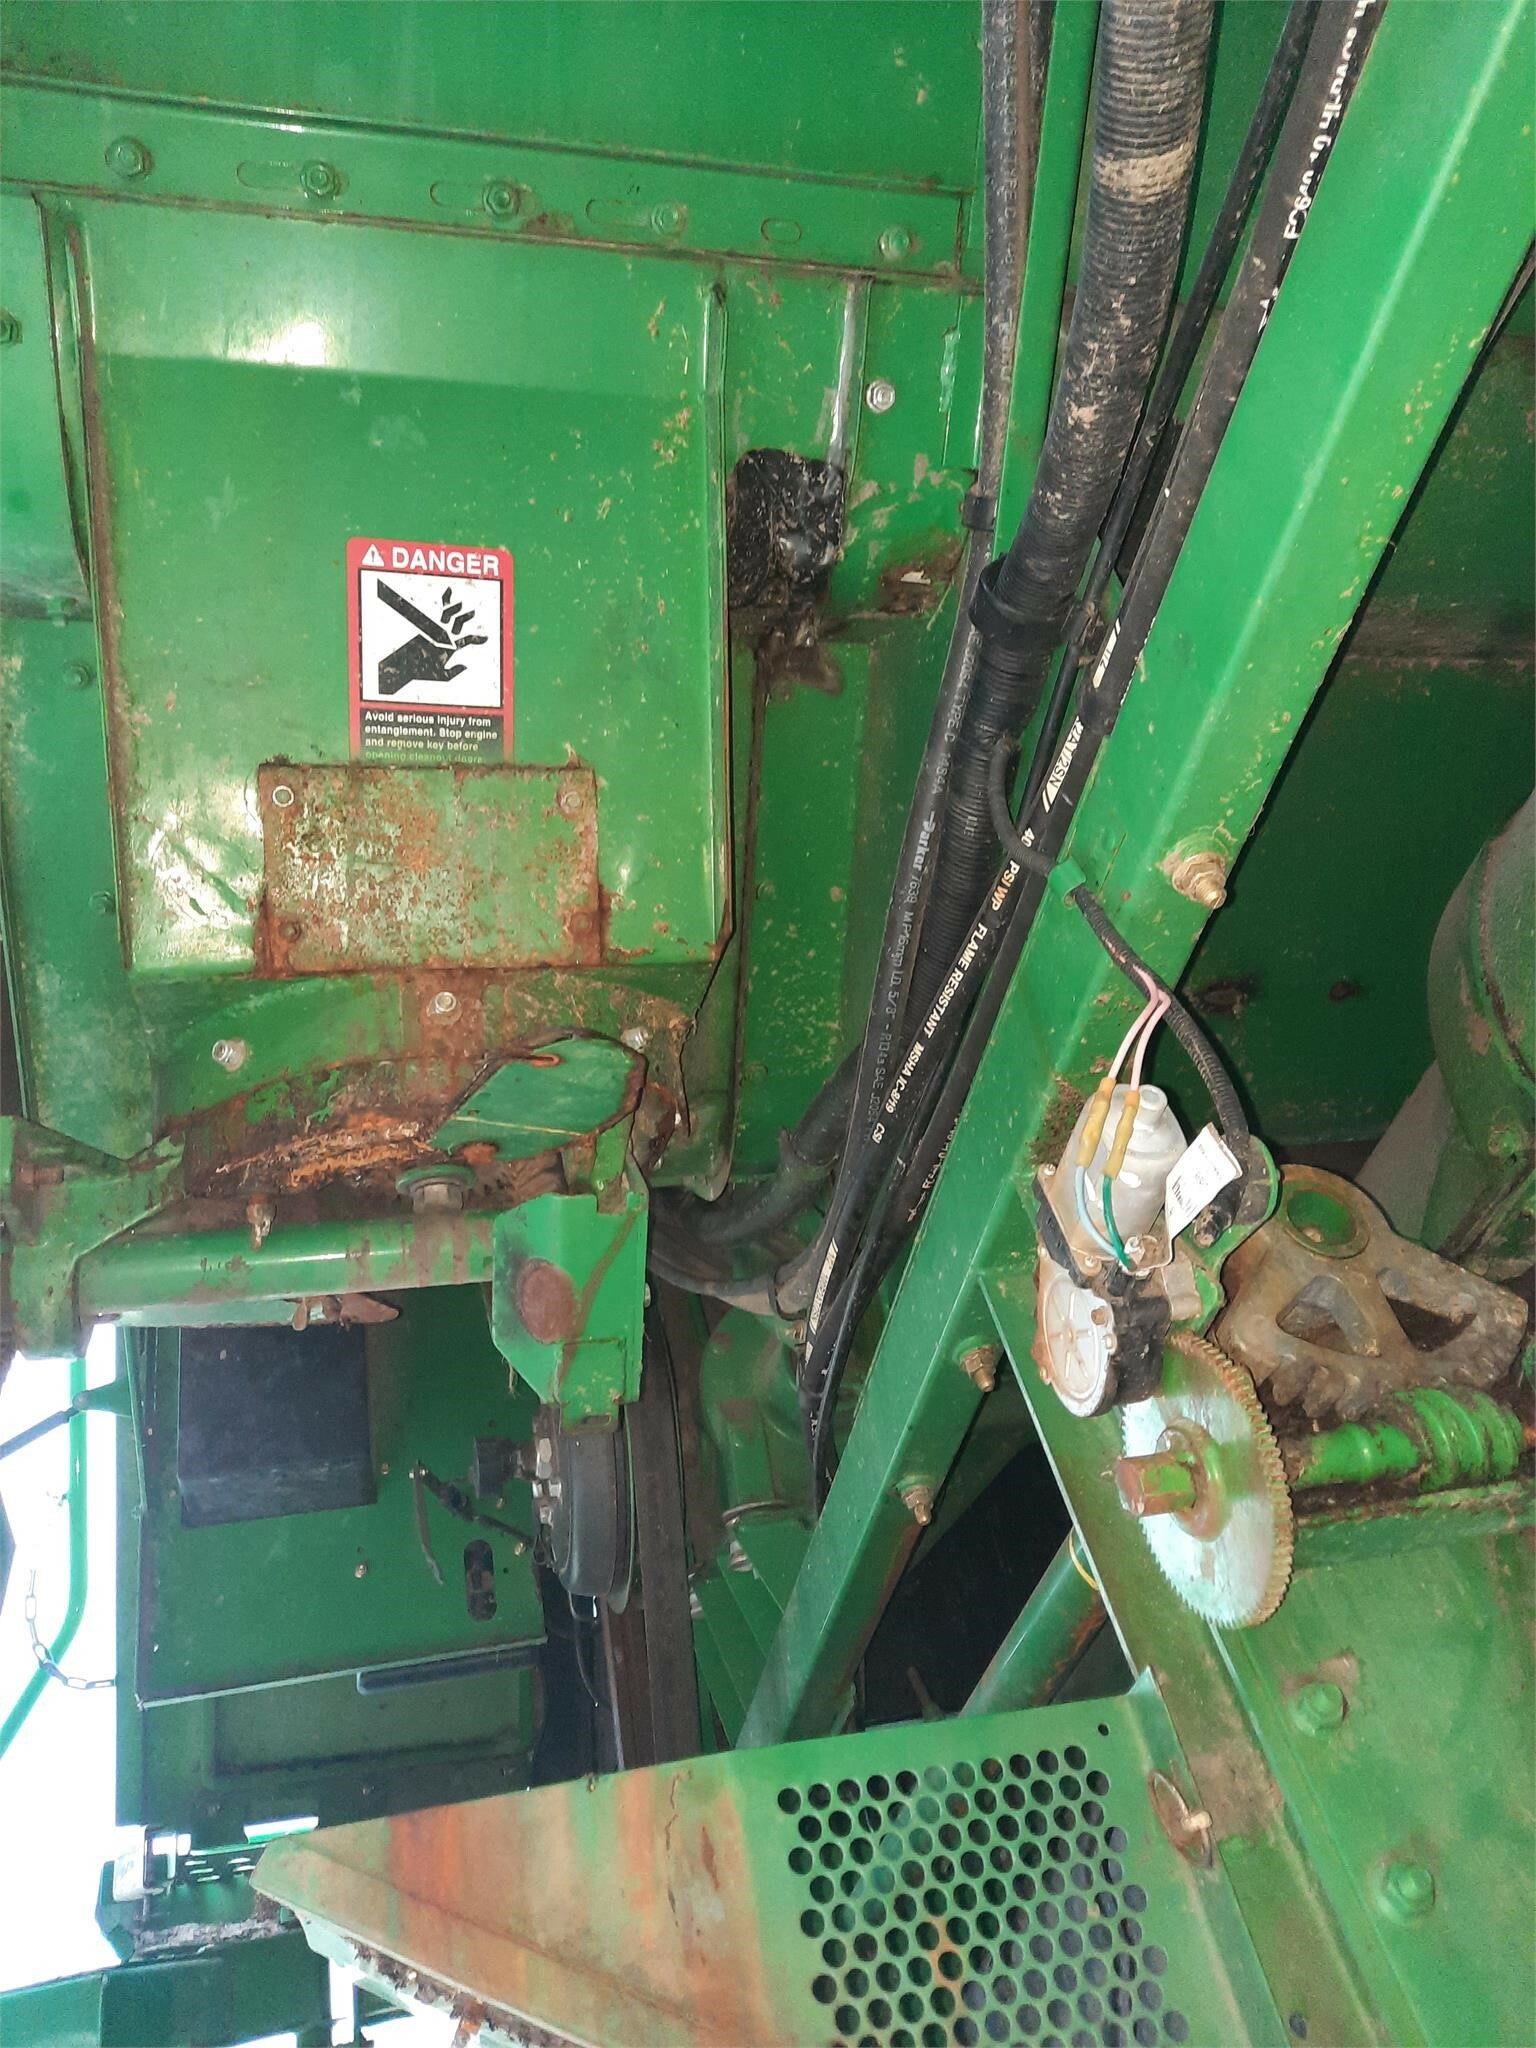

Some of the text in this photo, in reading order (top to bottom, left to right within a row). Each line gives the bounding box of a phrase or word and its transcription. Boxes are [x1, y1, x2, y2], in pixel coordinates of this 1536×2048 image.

[391, 546, 499, 576] DANGER
[365, 711, 491, 728] Avoid serious injury from
[365, 725, 498, 742] entanglement. Stop engine
[365, 737, 479, 751] and remove key before
[365, 751, 406, 762] opening
[1048, 720, 1083, 788] 2AT/2SN
[912, 818, 936, 872] Parker
[1001, 860, 1020, 888] PSI
[991, 884, 1009, 911] WP
[957, 922, 988, 971] FLAME
[924, 967, 964, 1039] RESISTANT
[902, 1041, 925, 1078] MSHA
[872, 1067, 887, 1090] SAE
[872, 1122, 886, 1144] CSI
